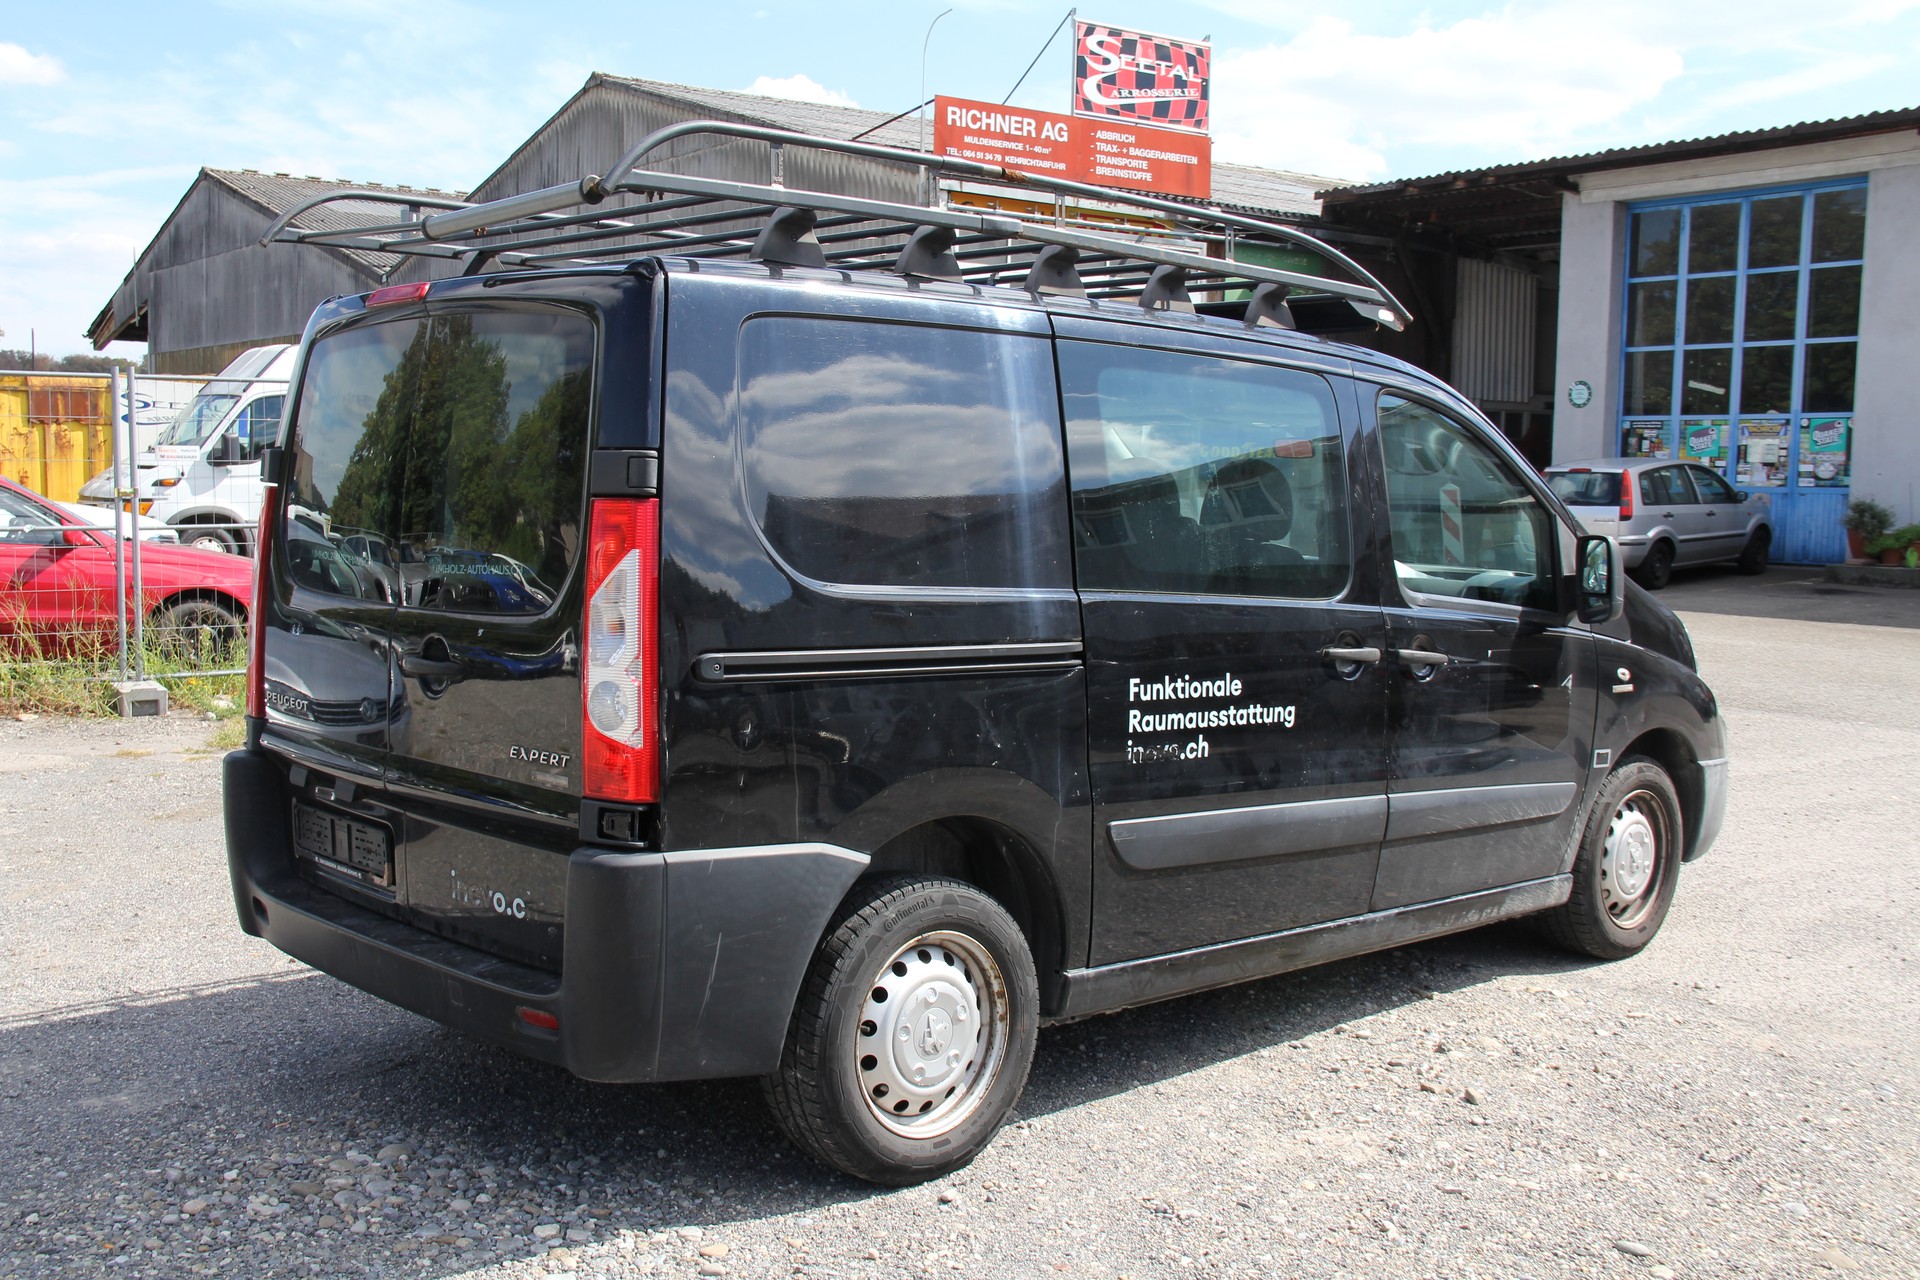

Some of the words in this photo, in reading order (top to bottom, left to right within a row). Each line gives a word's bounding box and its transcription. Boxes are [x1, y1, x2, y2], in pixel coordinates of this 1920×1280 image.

[1083, 70, 1199, 106] CARROSSERIE
[946, 106, 1037, 138] RICHNER
[1040, 121, 1069, 143] AG
[963, 135, 1024, 151] MULDENSERVICE
[1095, 130, 1136, 143] ABBRUCH
[946, 147, 962, 157] TEL:
[1004, 155, 1067, 171] KEHRICHTABFUHR
[1095, 154, 1149, 170] TRANSPORTE
[1128, 147, 1198, 165] BAGGERARBEITEN
[1095, 166, 1153, 182] BRENNSTOFFE
[1200, 442, 1276, 459] GOODYEA
[1129, 673, 1242, 702] Funktionale
[266, 690, 308, 712] PEUGEOT
[1128, 704, 1296, 734] Raumausstattung
[509, 745, 570, 768] EXPERT
[884, 897, 929, 932] Continental
